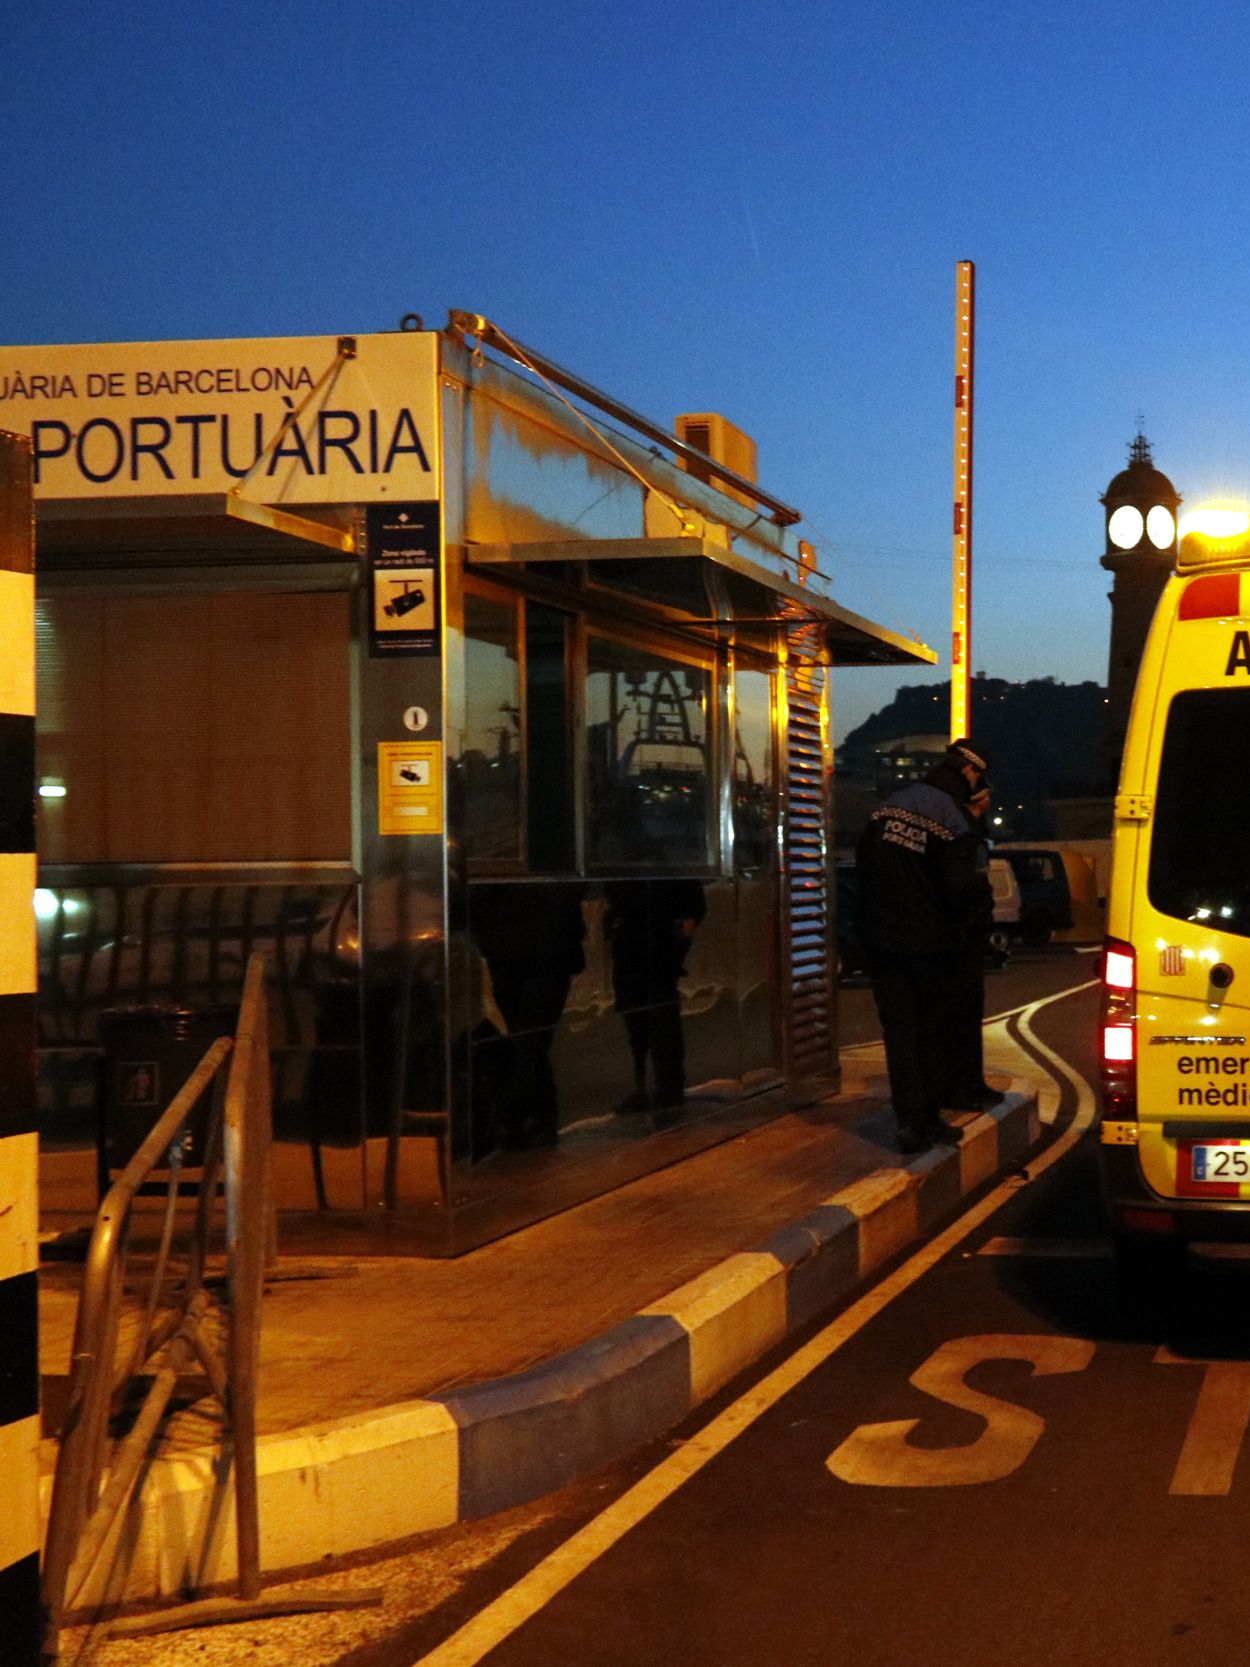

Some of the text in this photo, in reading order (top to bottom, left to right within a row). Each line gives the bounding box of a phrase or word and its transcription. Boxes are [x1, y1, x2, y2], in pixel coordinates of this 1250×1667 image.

[87, 372, 125, 398] DE
[136, 366, 317, 396] BARCELONA
[32, 396, 432, 484] PORTUÀRIA
